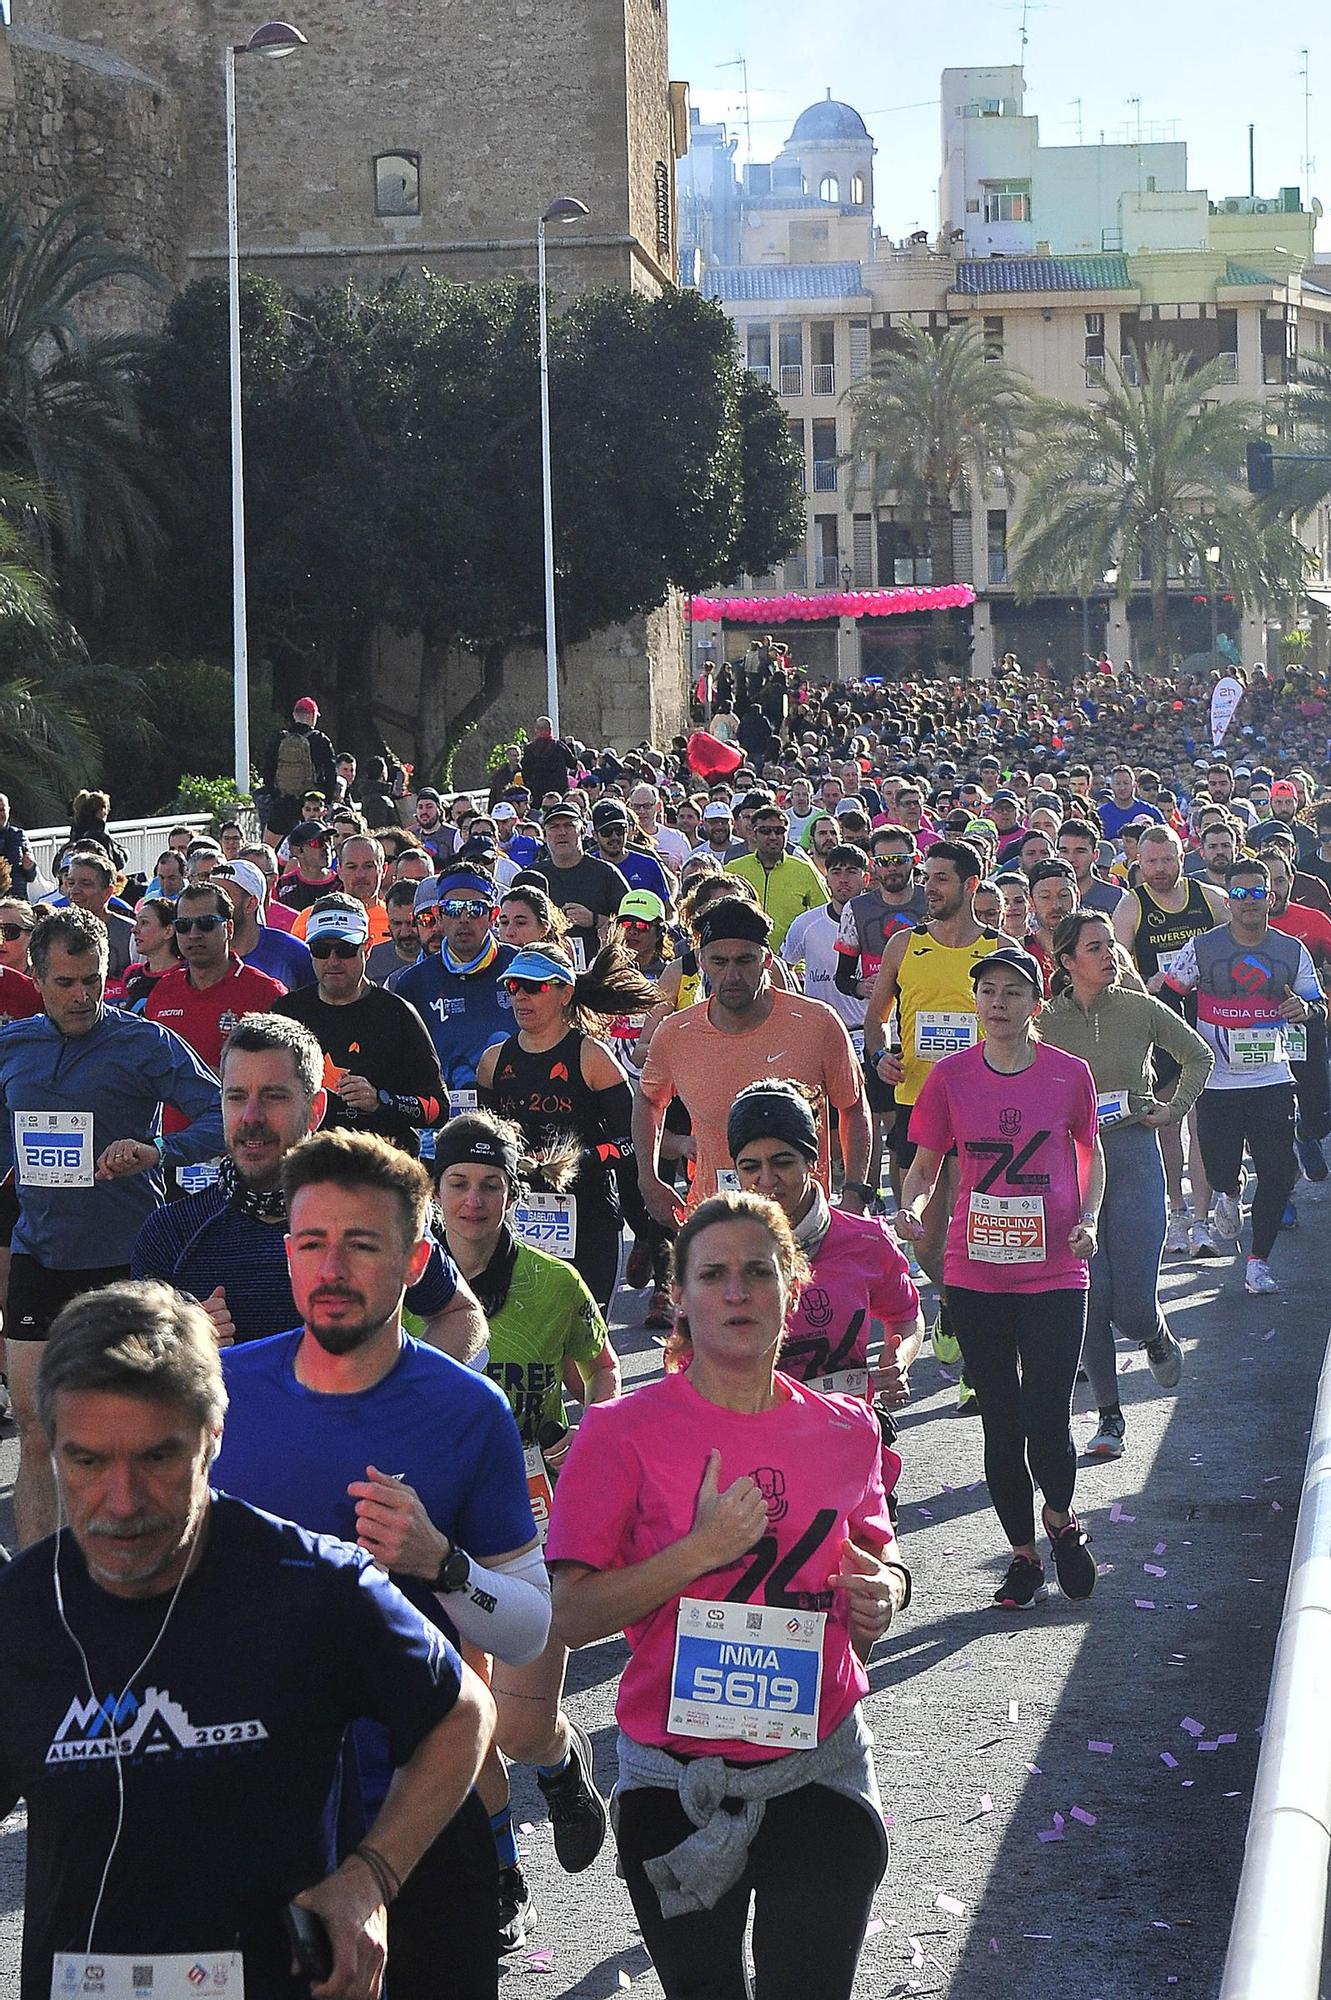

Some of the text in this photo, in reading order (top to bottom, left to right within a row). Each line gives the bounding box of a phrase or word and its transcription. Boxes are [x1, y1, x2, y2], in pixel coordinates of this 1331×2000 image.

[1149, 926, 1208, 944] RIVERSWAY
[1212, 1006, 1251, 1018] MEDIA
[919, 1038, 971, 1051] 2595
[1242, 1052, 1269, 1063] 251
[528, 1093, 574, 1113] 208
[26, 1149, 81, 1168] 2618
[974, 1214, 1037, 1229] KAROLINA
[973, 1227, 1038, 1248] 5367
[486, 1362, 556, 1392] FREE
[718, 1644, 781, 1671] INMA
[692, 1667, 799, 1712] 5619
[195, 1723, 260, 1744] 2023
